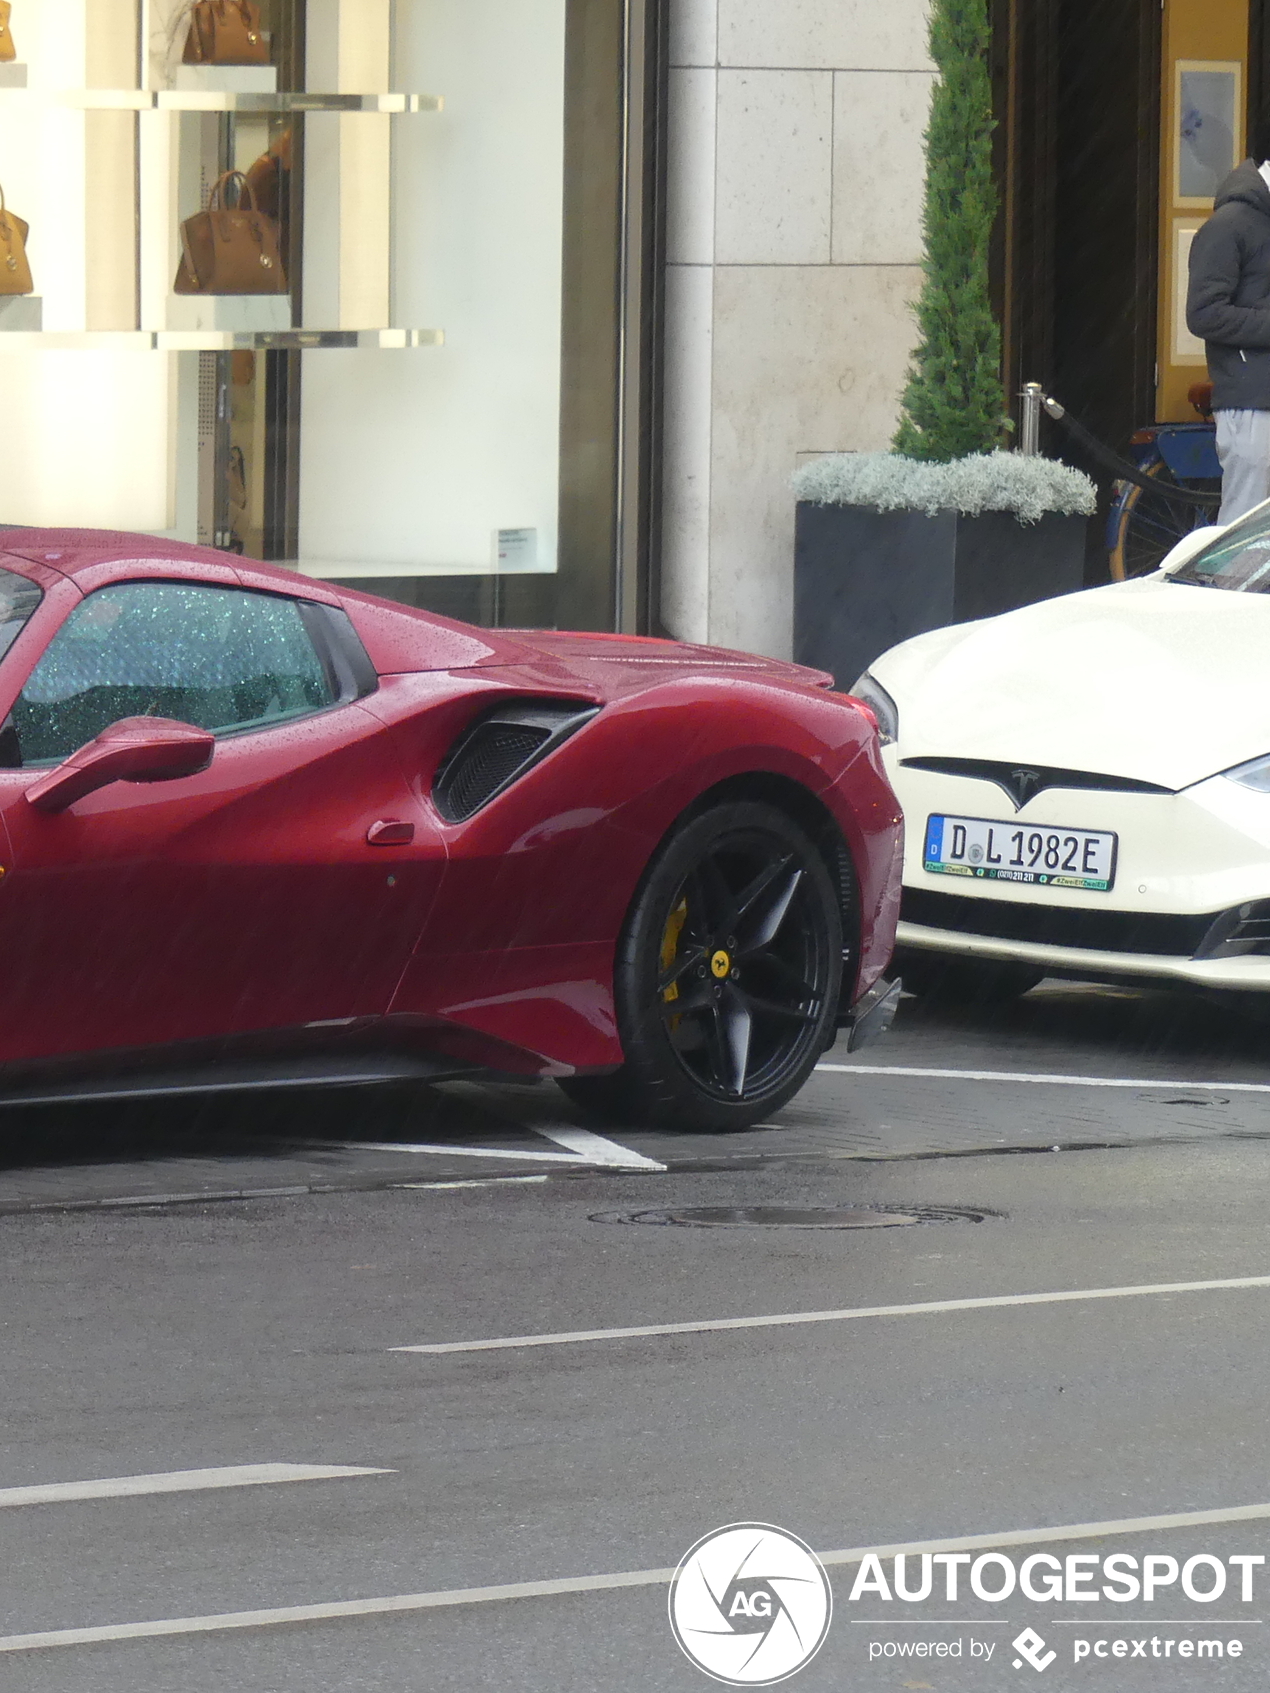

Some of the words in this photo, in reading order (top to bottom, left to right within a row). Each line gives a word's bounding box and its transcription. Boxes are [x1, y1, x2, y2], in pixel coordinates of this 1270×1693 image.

[931, 844, 938, 855] D
[950, 824, 967, 859] D
[986, 828, 1001, 863] L
[1009, 831, 1100, 874] 1982E
